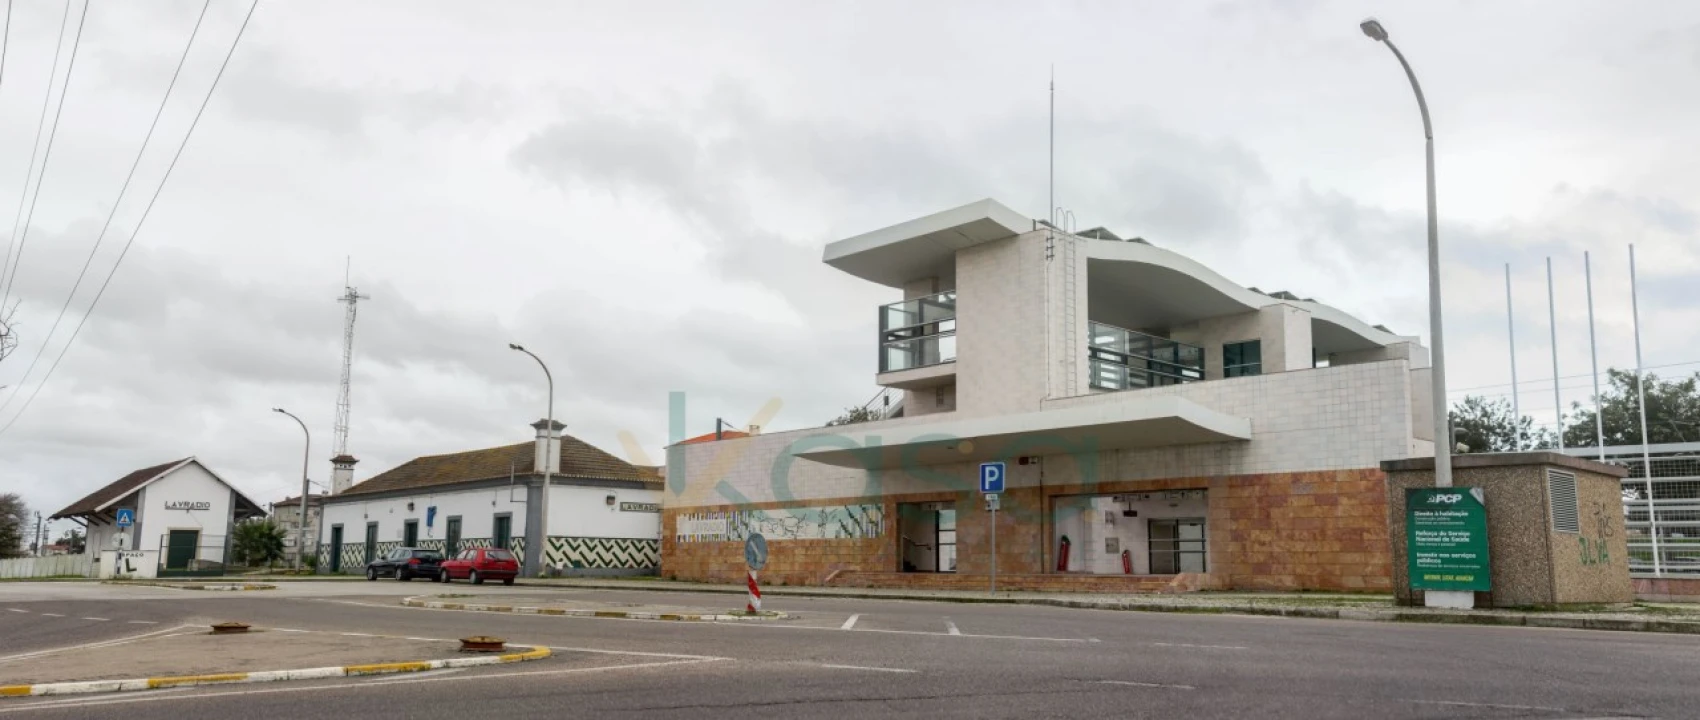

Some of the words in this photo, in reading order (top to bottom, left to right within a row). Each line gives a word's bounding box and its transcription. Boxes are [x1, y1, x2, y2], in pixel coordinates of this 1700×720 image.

[985, 466, 999, 490] P
[1436, 494, 1462, 503] PCP
[165, 501, 210, 510] LAVRADIO
[125, 558, 137, 572] L
